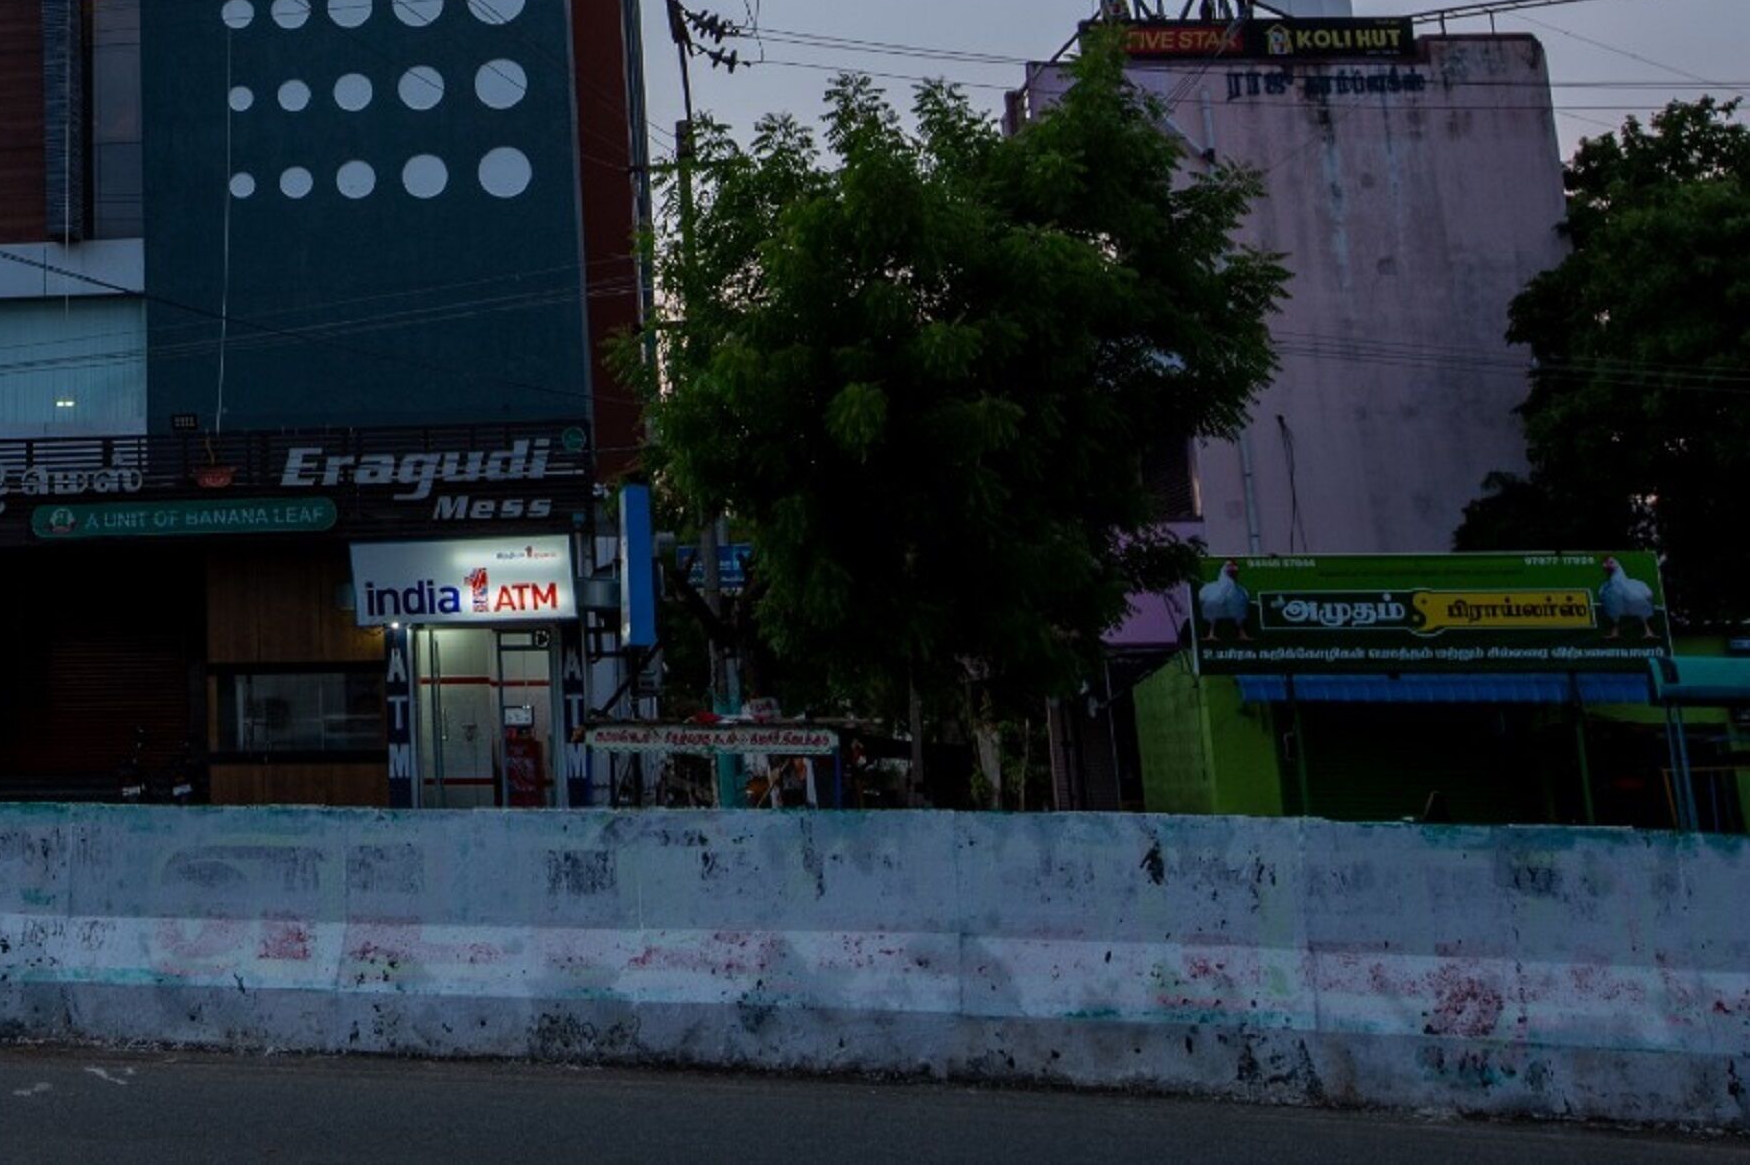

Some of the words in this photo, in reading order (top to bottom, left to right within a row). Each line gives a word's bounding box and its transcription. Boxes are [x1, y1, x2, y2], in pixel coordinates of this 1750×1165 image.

[1296, 29, 1351, 50] KOLI
[1355, 27, 1402, 48] HUT
[279, 438, 551, 502] Eragudi
[104, 511, 146, 528] UNIT
[153, 509, 180, 528] OF
[185, 507, 269, 526] BANANA
[273, 505, 326, 524] LEAF
[431, 495, 552, 522] Mess
[1282, 592, 1406, 627] அமுதம்
[386, 647, 411, 779] ATM
